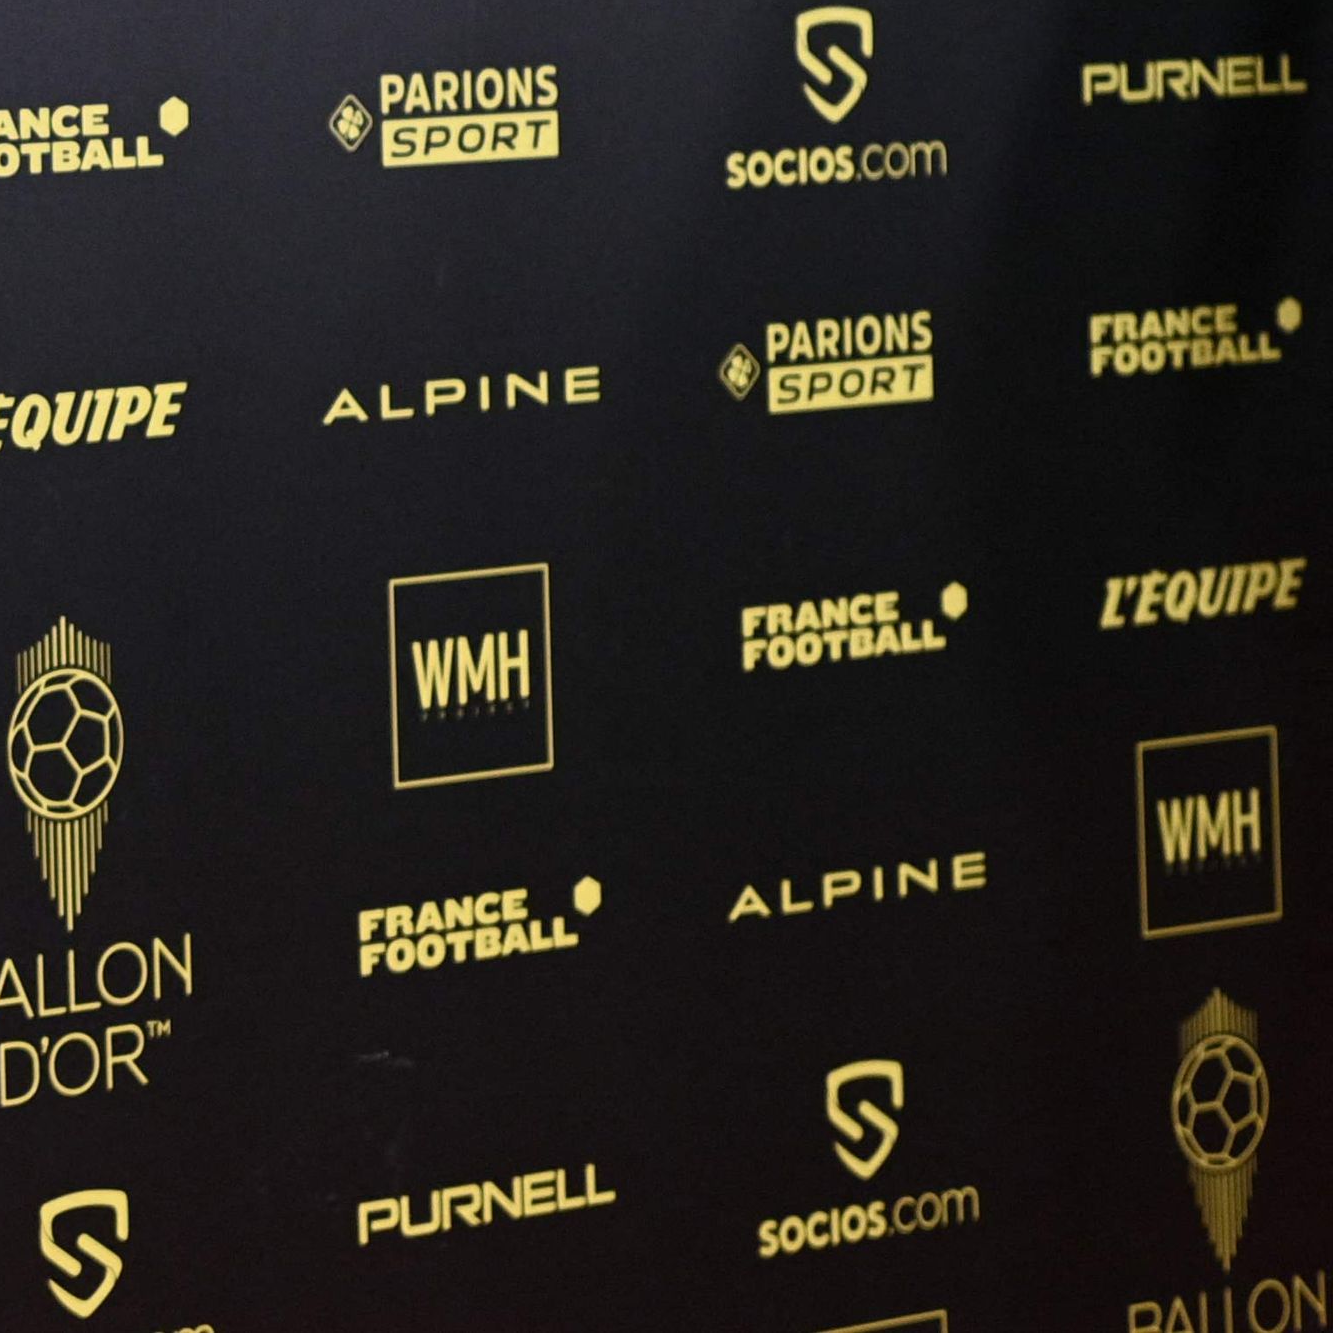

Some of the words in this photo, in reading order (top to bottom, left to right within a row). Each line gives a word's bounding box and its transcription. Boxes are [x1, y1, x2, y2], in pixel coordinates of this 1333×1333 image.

[381, 66, 557, 113] PARIONS
[1083, 58, 1304, 103] PURNELL
[391, 120, 551, 158] SPORT
[727, 142, 946, 188] SOCIOS.com
[768, 312, 931, 361] PARIONS
[1090, 306, 1235, 347] FRANCE
[1091, 334, 1280, 375] FOOTBALL
[323, 367, 599, 424] ALPINE
[777, 364, 926, 405] SPORT
[742, 592, 898, 642] FRANCE
[1101, 559, 1304, 628] L'ÉQUIPE
[413, 630, 529, 708] WMH
[743, 620, 946, 670] FOOTBALL
[1159, 790, 1259, 862] WMH
[729, 853, 985, 921] ALPINE
[359, 889, 528, 942] FRANCE
[360, 917, 578, 976] FOOTBALL
[358, 1164, 615, 1244] PURNELL
[759, 1187, 978, 1257] SOCIOS.com
